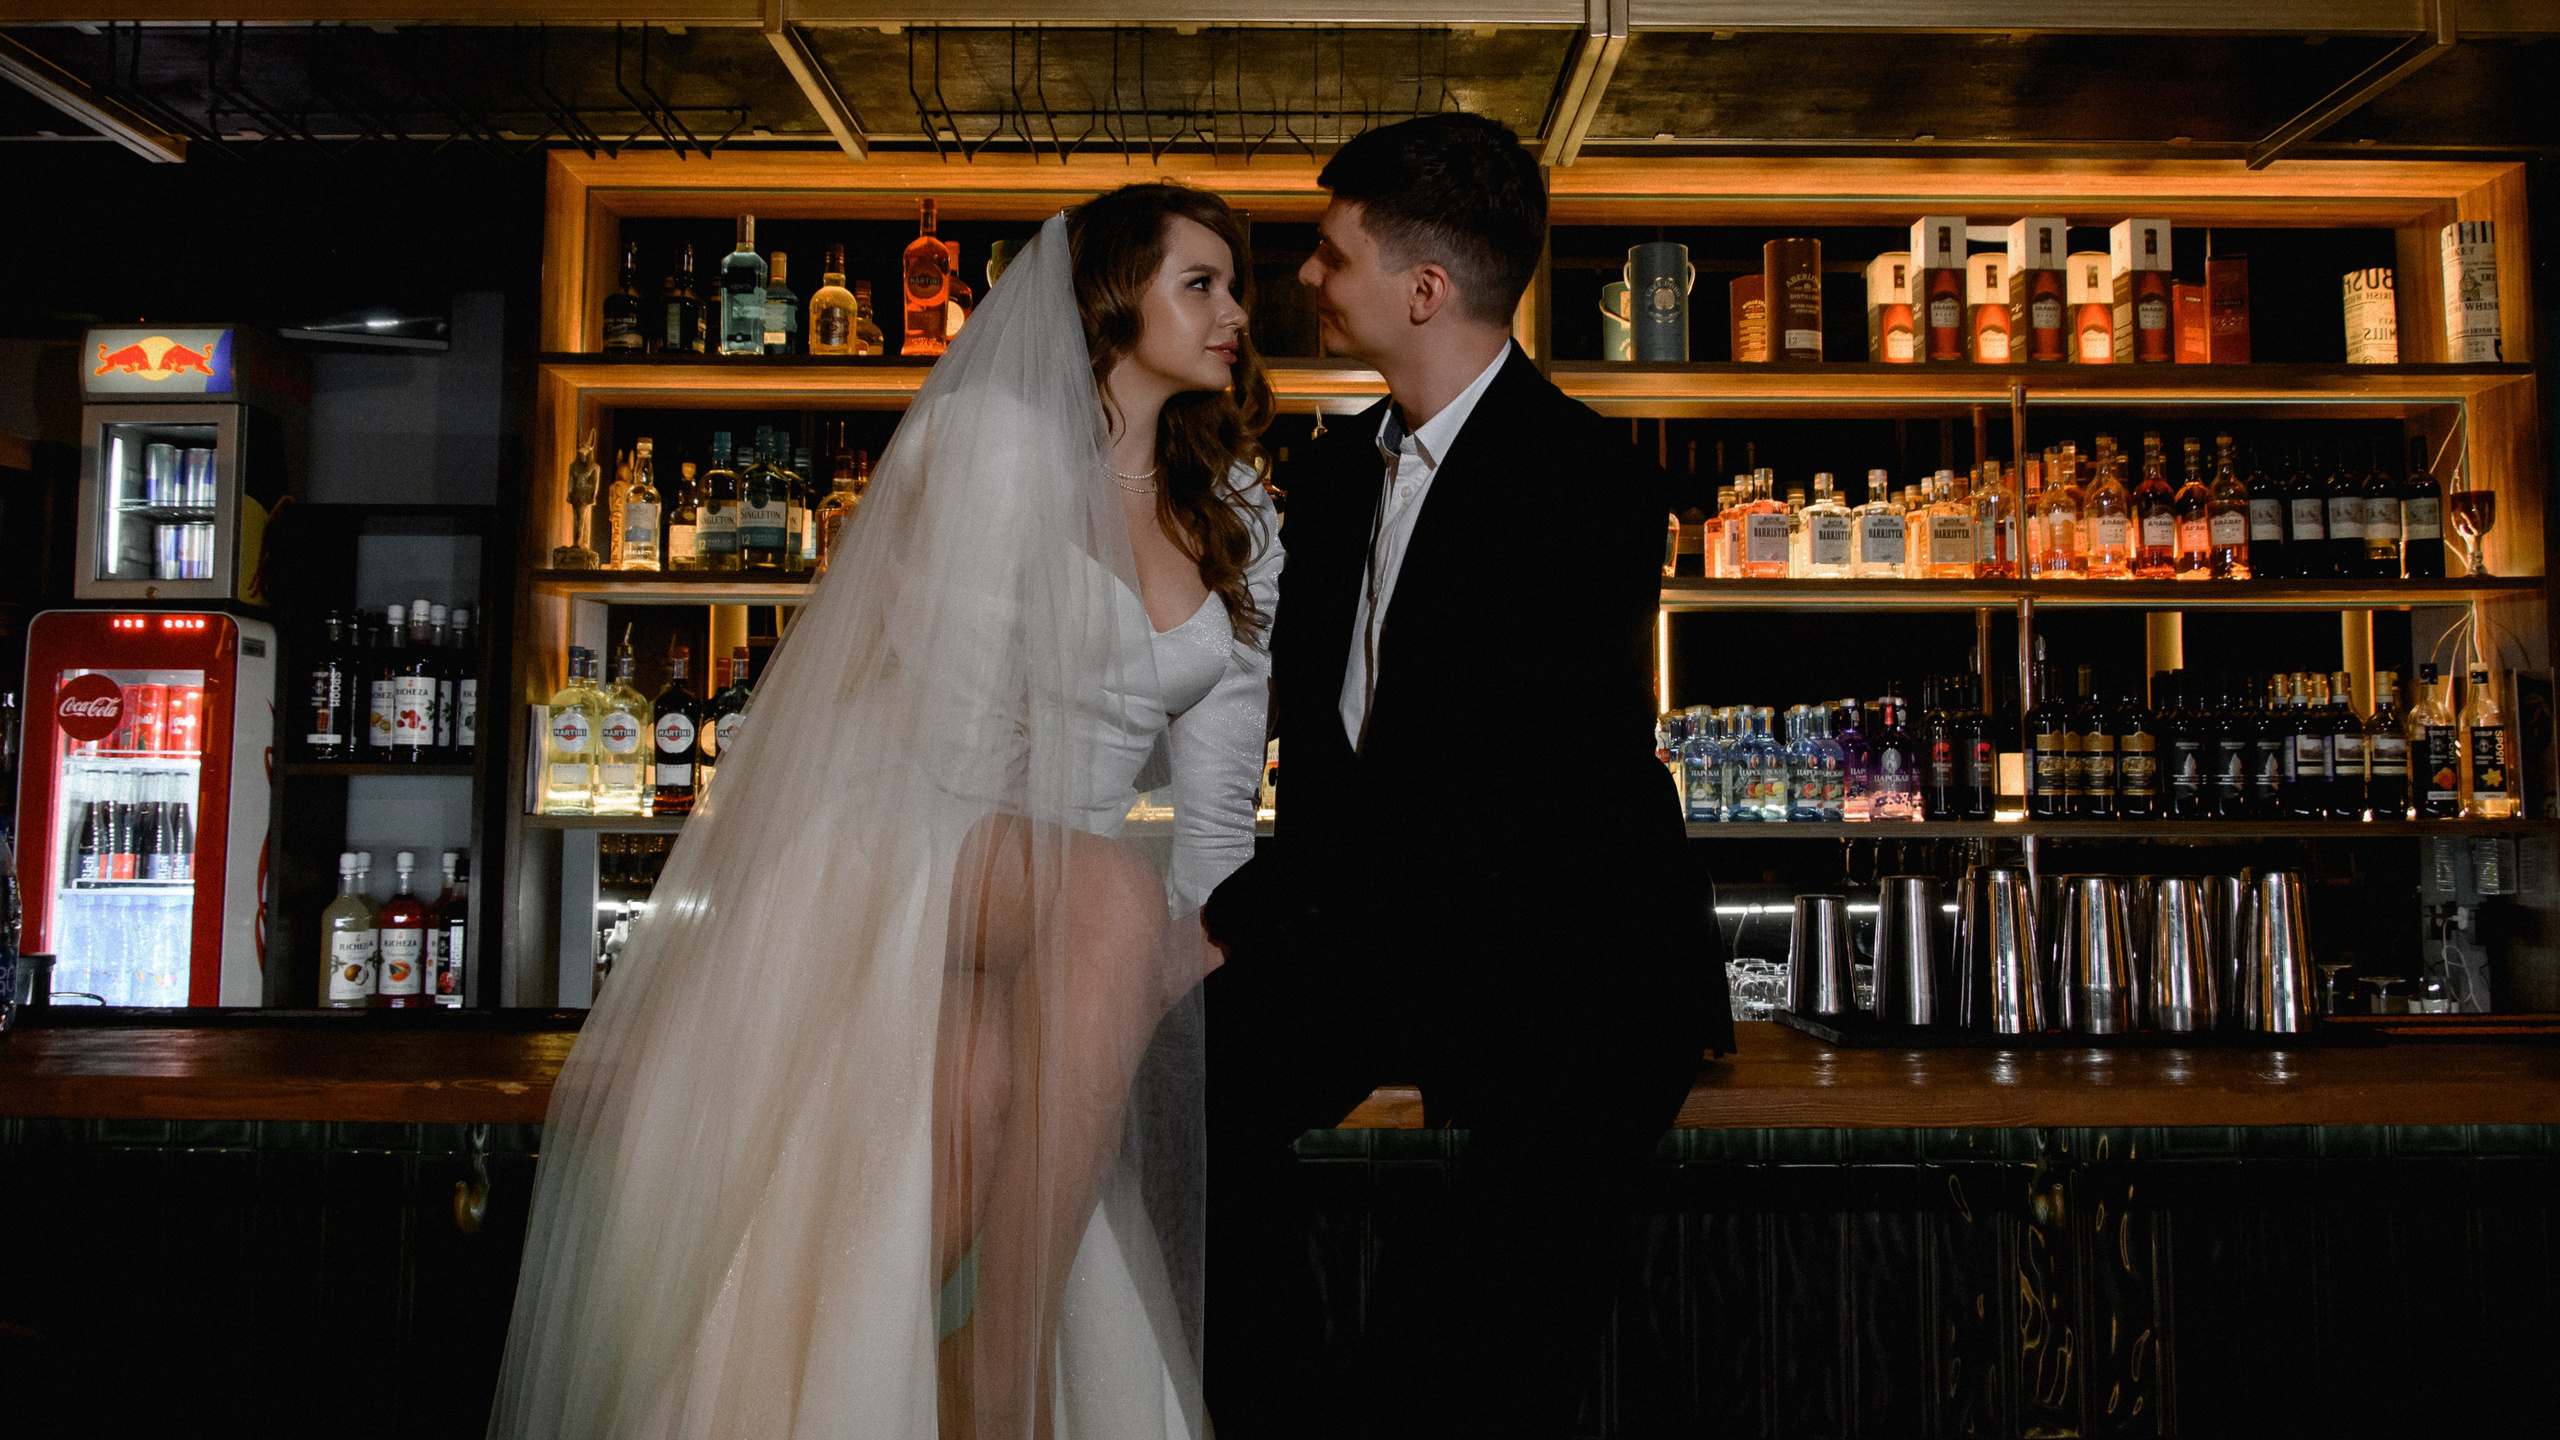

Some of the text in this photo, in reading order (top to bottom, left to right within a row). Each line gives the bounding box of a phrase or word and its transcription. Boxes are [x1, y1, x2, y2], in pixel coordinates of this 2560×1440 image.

[909, 277, 941, 285] MARTINI
[740, 509, 781, 520] SINGLETON
[1868, 529, 1904, 539] BARRISTER
[1934, 529, 1970, 539] BARRISTER
[698, 539, 706, 550] 12
[741, 534, 751, 545] 12
[114, 619, 206, 630] ICE COLD
[396, 688, 429, 696] RICHEZA
[59, 696, 122, 718] Coca-Cola
[554, 728, 588, 737] MARTINI
[602, 728, 637, 737] MARTINI
[658, 728, 692, 738] MARTINI
[1874, 774, 1910, 782] ЦАРСКАЯ
[383, 939, 418, 947] RICHEZA
